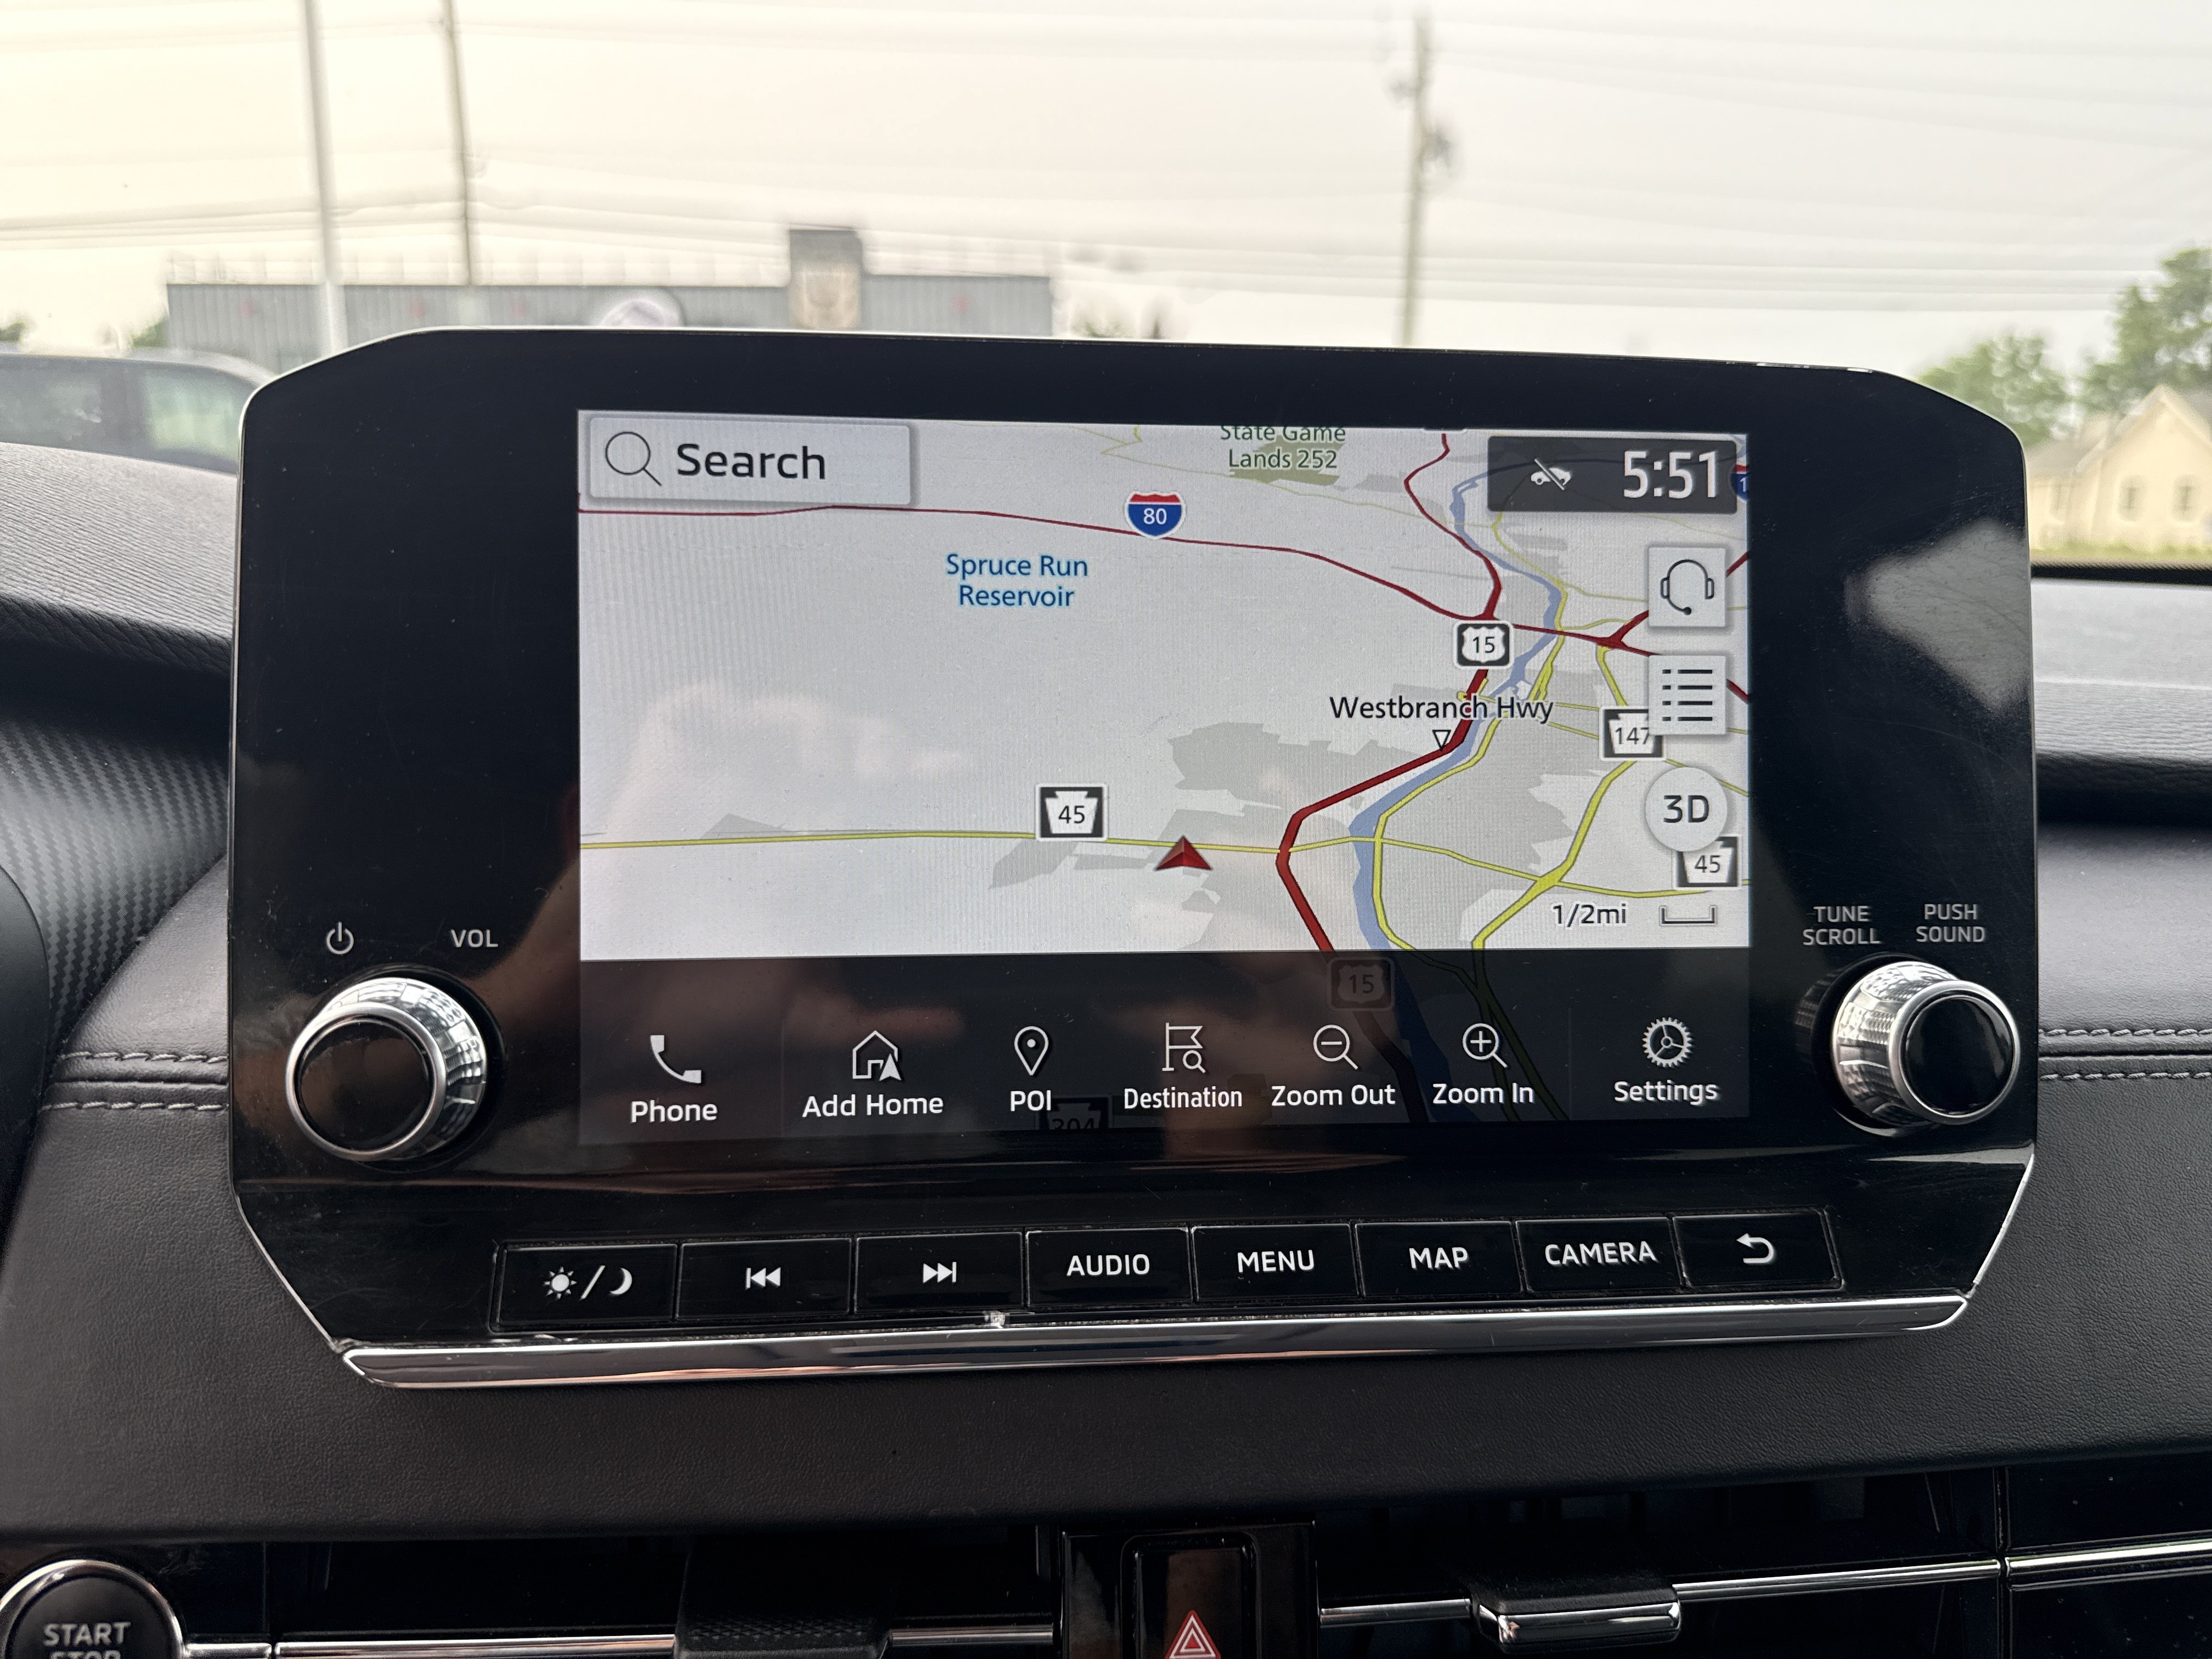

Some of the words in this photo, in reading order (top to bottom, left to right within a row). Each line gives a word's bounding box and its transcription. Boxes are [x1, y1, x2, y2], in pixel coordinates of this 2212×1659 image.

[1221, 425, 1276, 440] State
[1283, 426, 1346, 441] Game
[677, 443, 826, 479] Search
[1229, 448, 1290, 469] Lands
[1298, 450, 1337, 469] 252
[1624, 451, 1718, 499] 5:51
[1143, 508, 1167, 525] 80
[946, 554, 1031, 580] Spruce
[1040, 556, 1088, 577] Run
[959, 585, 1074, 607] Reservoir
[1472, 636, 1496, 654] 15
[1330, 695, 1488, 719] Westbranch
[1497, 697, 1553, 724] Hwy
[1615, 727, 1650, 745] 147
[1058, 805, 1085, 824] 45
[1663, 795, 1709, 823] 3D
[1694, 855, 1721, 873] 45
[1553, 904, 1627, 927] 1/2mi
[1814, 906, 1871, 922] TUNE
[1924, 904, 1978, 921] PUSH
[450, 929, 499, 948] VOL
[1803, 928, 1882, 945] SCROLL
[1916, 926, 1986, 943] SOUND
[1348, 975, 1374, 994] 15
[1010, 1090, 1052, 1111] POI
[1124, 1086, 1243, 1109] Destination
[1272, 1086, 1342, 1107] Zoom
[1351, 1085, 1396, 1105] Out
[1432, 1083, 1504, 1104] Zoom
[1511, 1082, 1535, 1104] In
[1613, 1080, 1719, 1106] Settings
[630, 1100, 718, 1123] Phone
[802, 1094, 856, 1118] Add
[866, 1094, 944, 1116] Home
[1237, 1249, 1315, 1273] MENU
[1408, 1246, 1469, 1271] MAP
[1545, 1241, 1658, 1265] CAMERA
[1066, 1254, 1150, 1276] AUDIO
[43, 1621, 131, 1646] START
